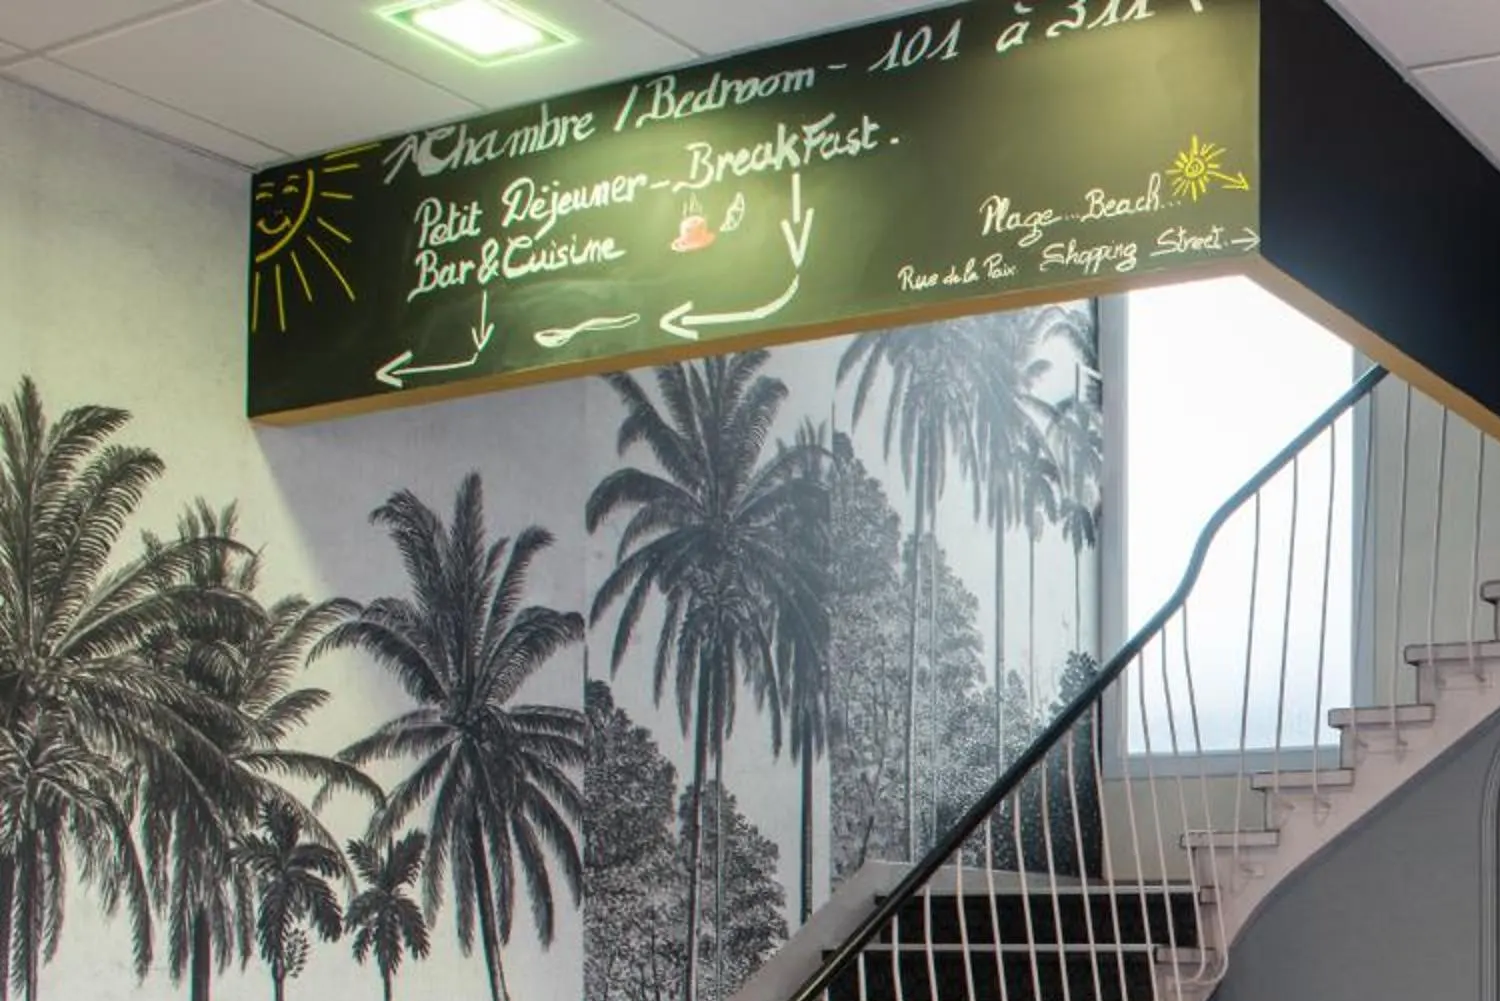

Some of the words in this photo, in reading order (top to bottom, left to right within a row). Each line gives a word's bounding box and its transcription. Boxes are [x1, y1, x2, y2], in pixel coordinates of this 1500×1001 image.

[417, 103, 595, 176] Chambre
[868, 20, 961, 72] 101
[414, 197, 483, 248] Petit
[407, 249, 476, 302] Bar
[503, 234, 626, 279] Cuisine
[898, 266, 939, 291] Rue
[1040, 239, 1138, 275] Shopping
